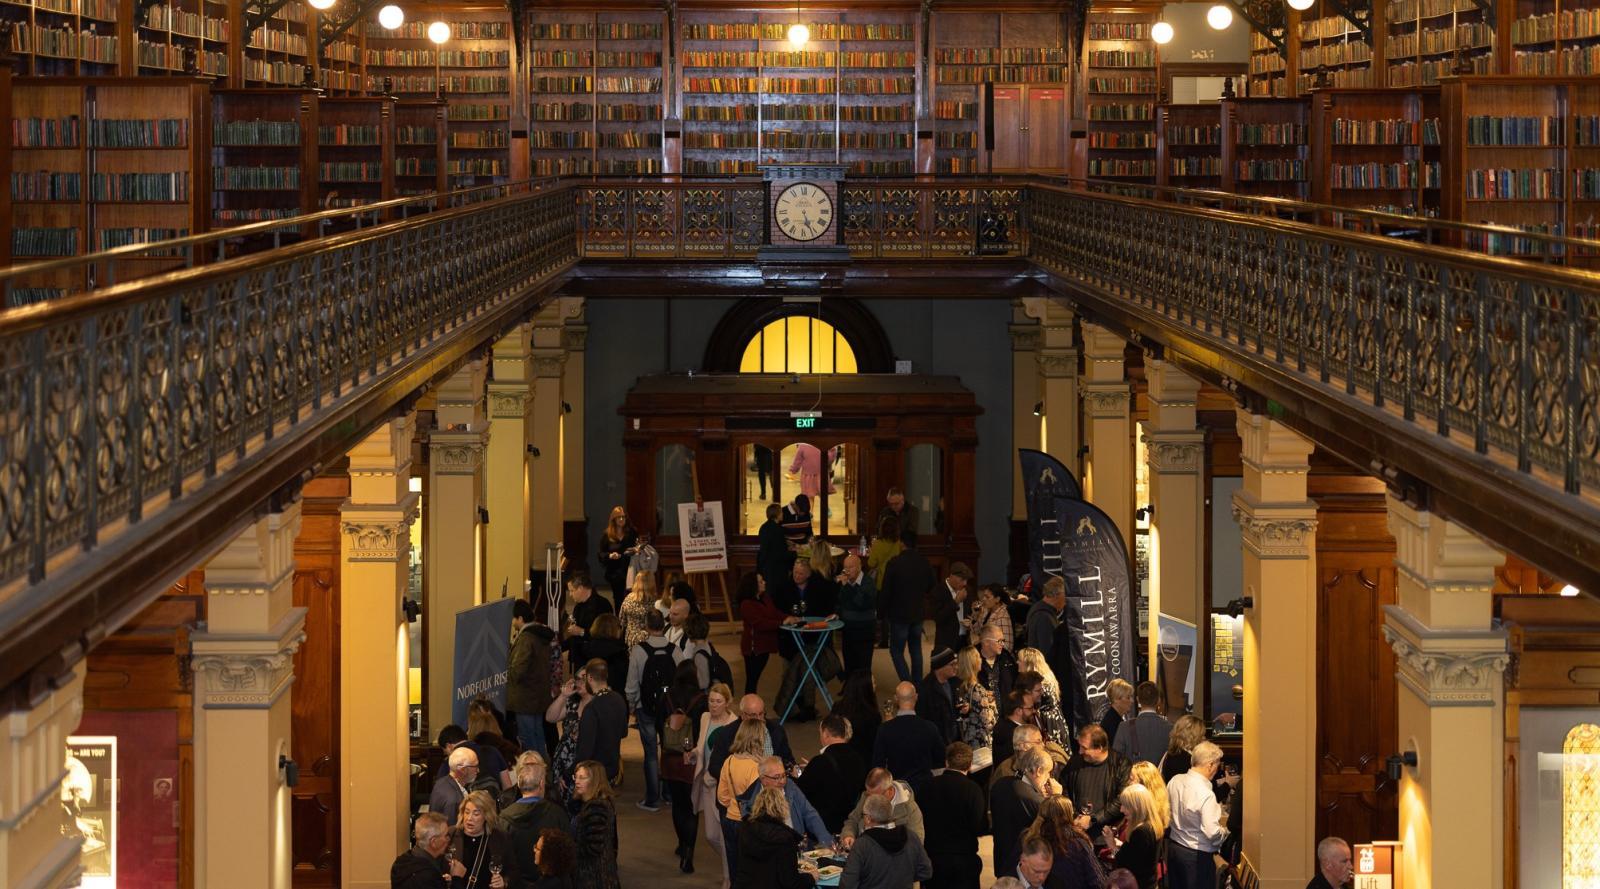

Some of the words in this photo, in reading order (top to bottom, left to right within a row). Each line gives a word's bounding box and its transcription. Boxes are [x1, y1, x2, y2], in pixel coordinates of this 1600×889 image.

[796, 418, 815, 428] EXIT
[1078, 564, 1108, 702] RYMILL
[1109, 586, 1121, 675] COONAWARRA
[457, 676, 493, 701] NORFOLK
[80, 748, 90, 757] ARE
[91, 748, 105, 757] YOU?
[1361, 877, 1378, 889] Lift
